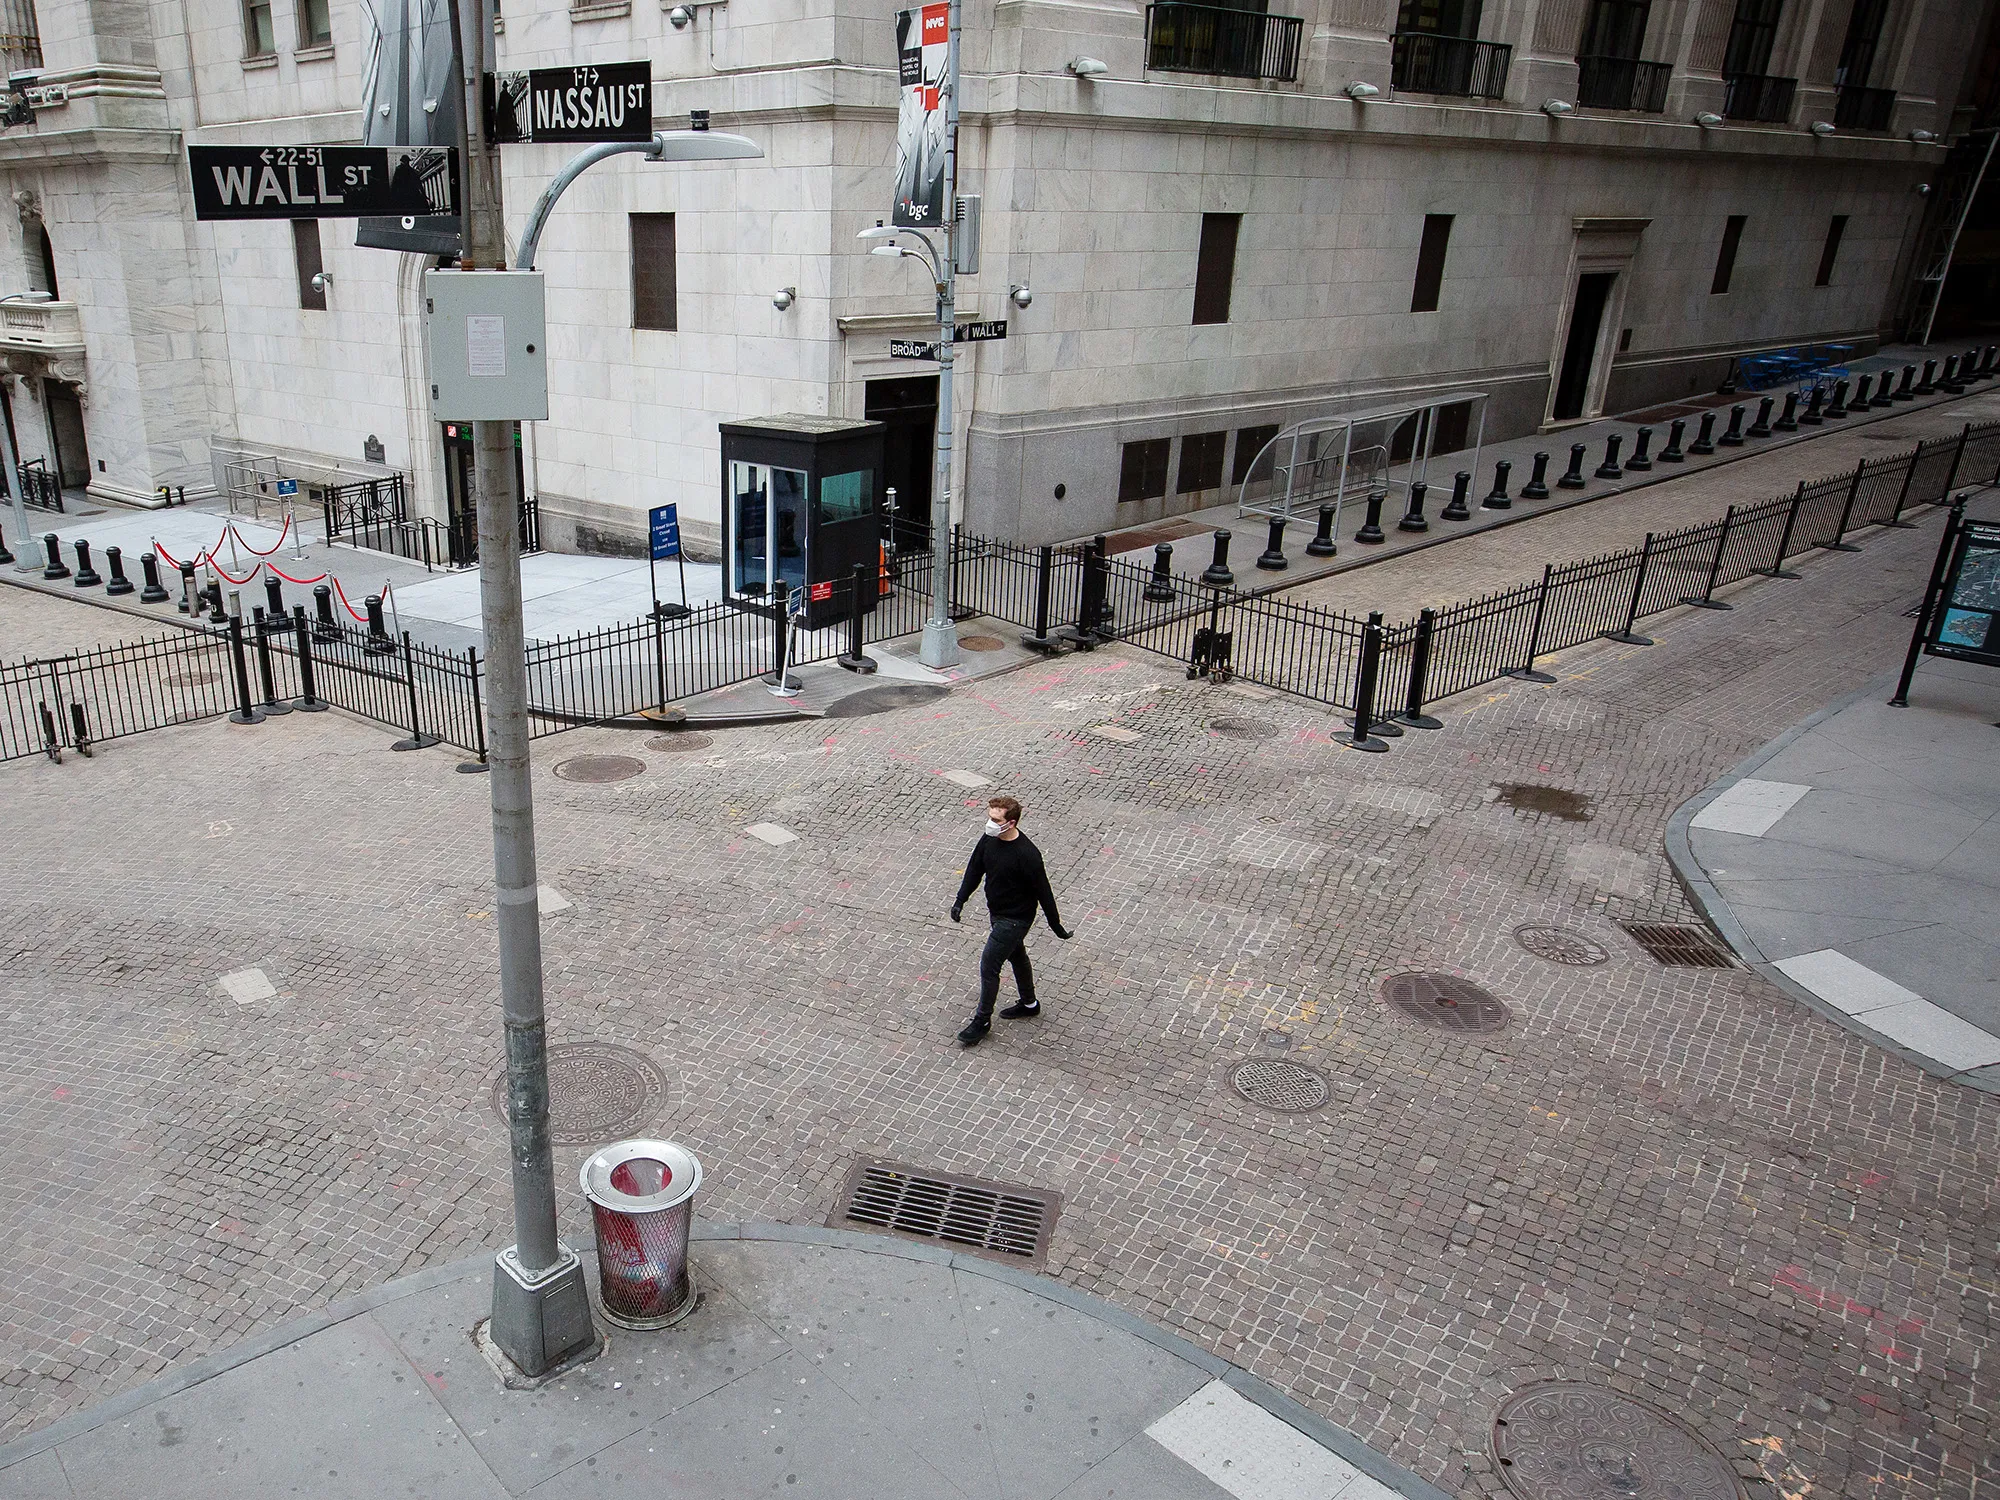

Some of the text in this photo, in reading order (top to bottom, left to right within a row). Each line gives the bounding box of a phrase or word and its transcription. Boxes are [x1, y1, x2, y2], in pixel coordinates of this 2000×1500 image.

[926, 17, 944, 30] NYC
[573, 68, 588, 86] 1-7
[536, 84, 645, 128] NASSAU ST
[277, 148, 323, 166] 22-51
[212, 166, 372, 205] WALL ST
[909, 201, 929, 221] bgc
[972, 326, 997, 338] WALL
[892, 344, 921, 356] BROAD
